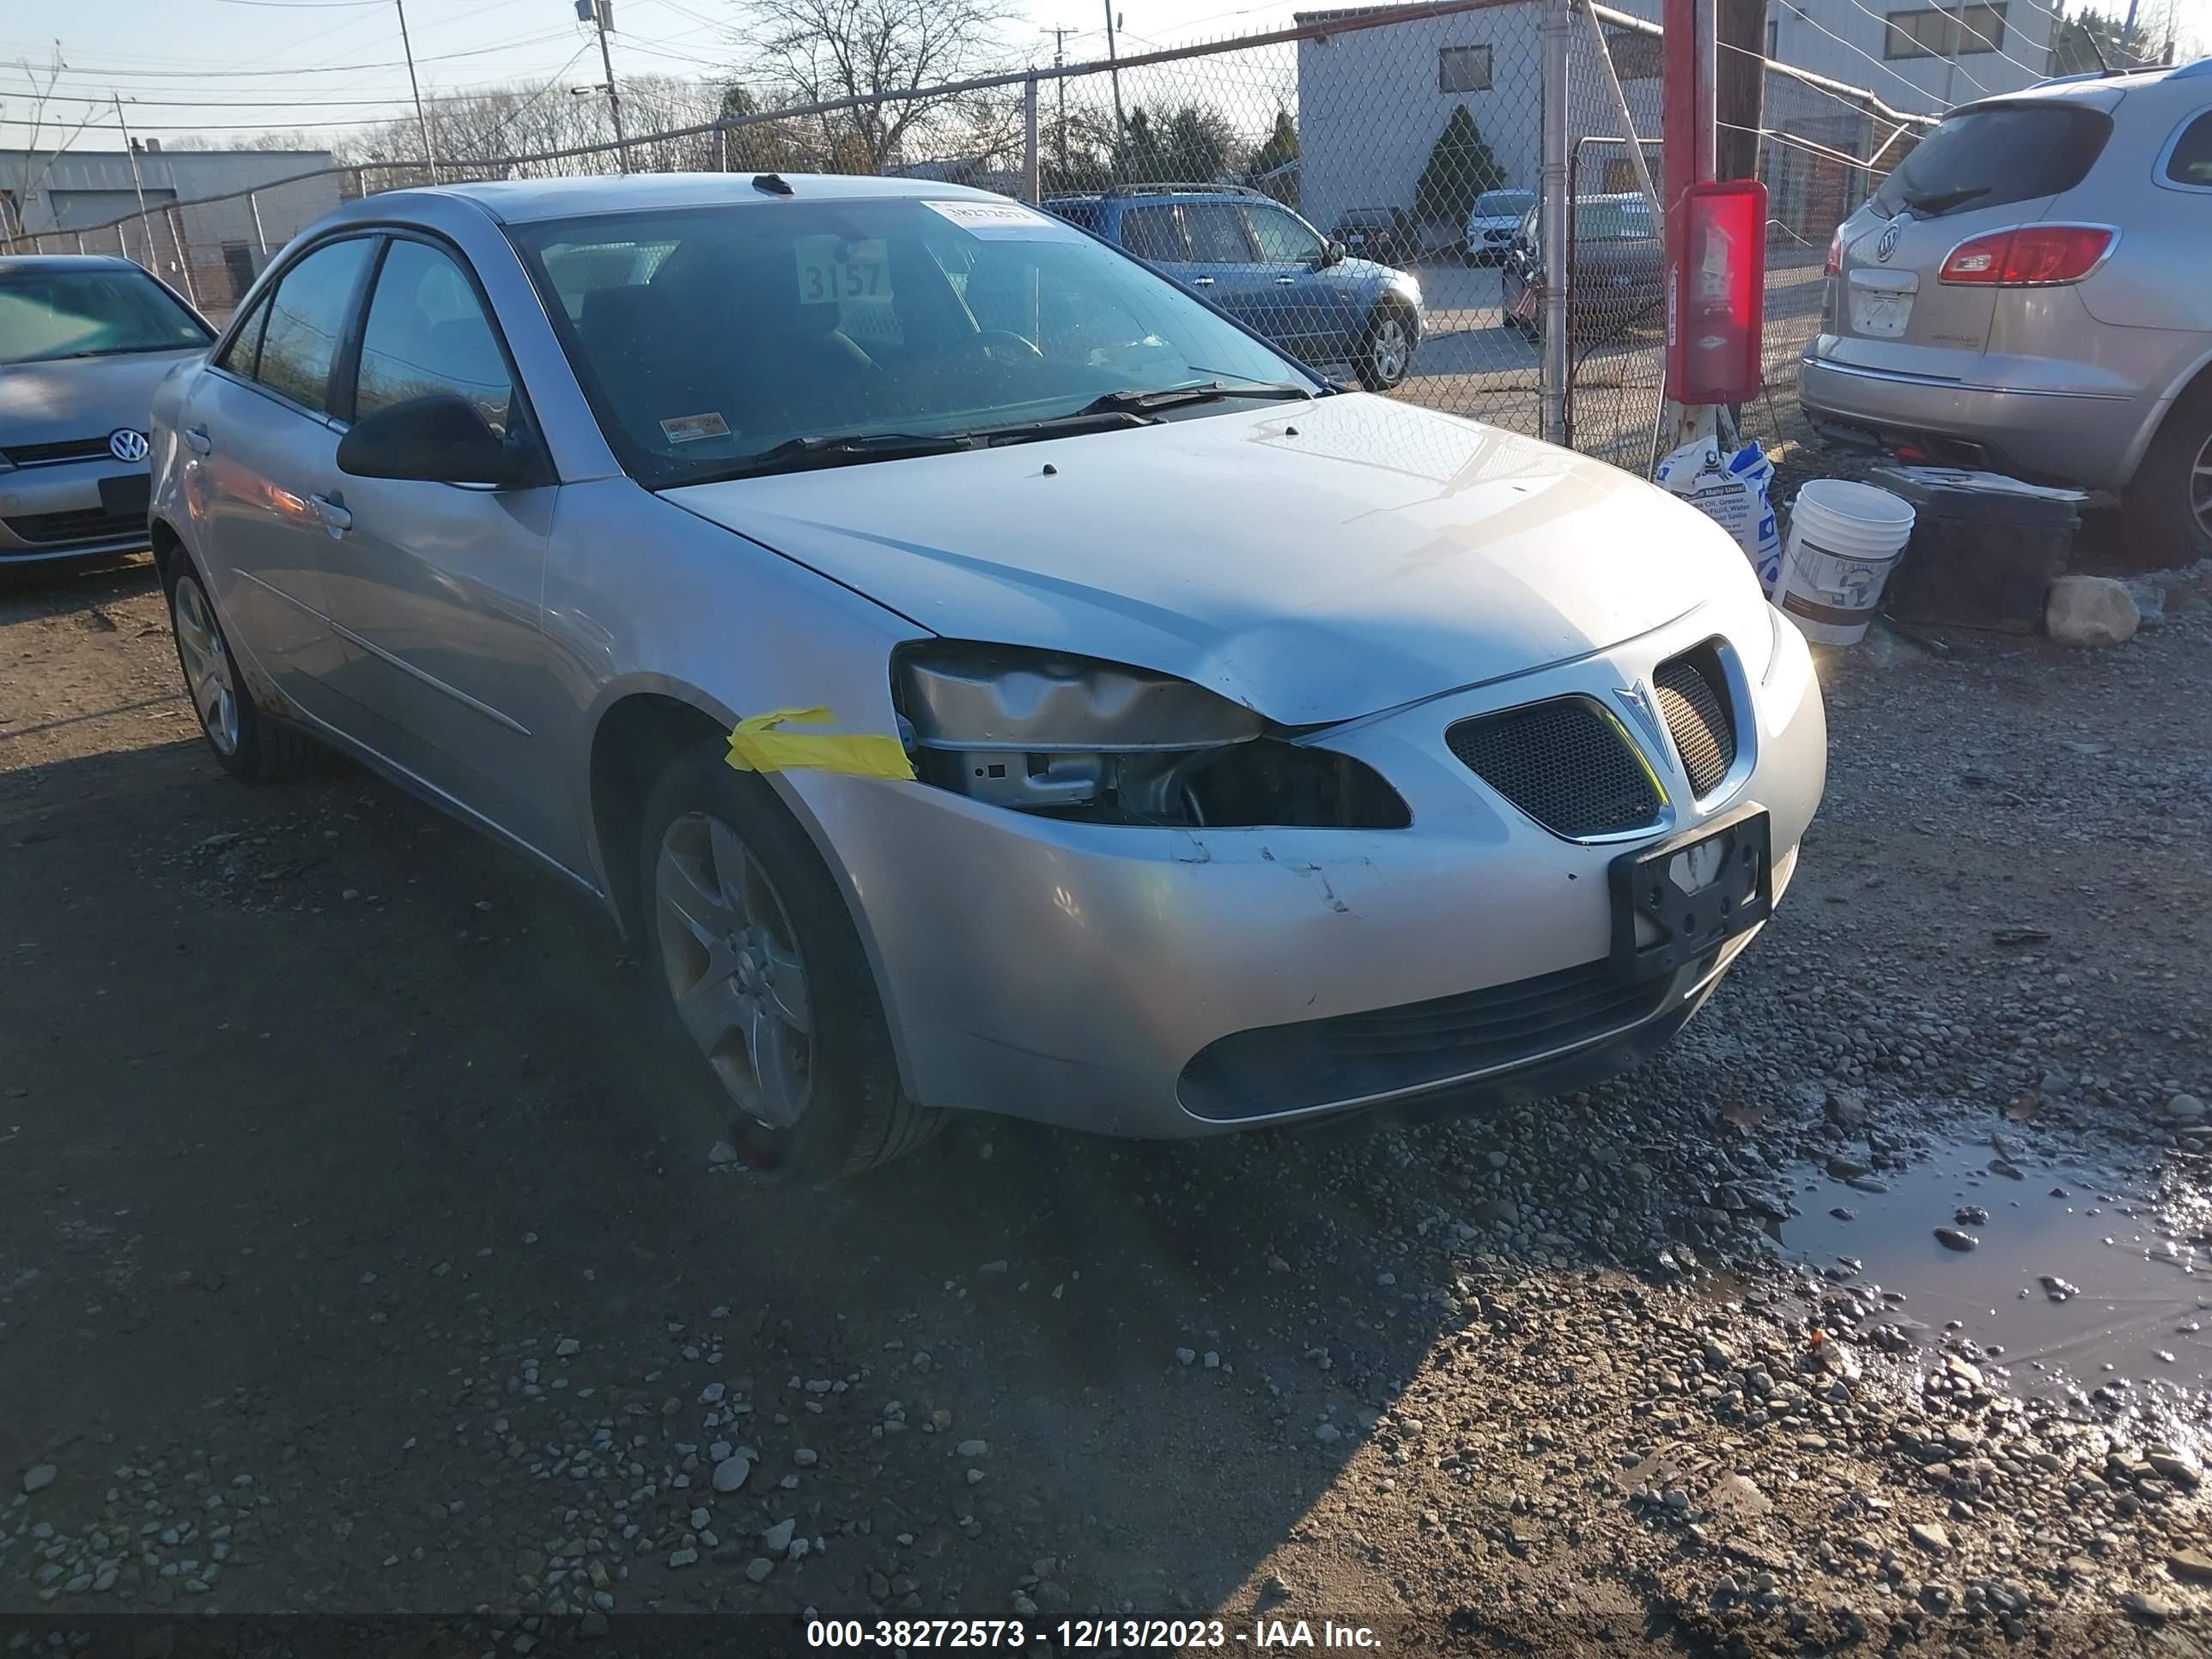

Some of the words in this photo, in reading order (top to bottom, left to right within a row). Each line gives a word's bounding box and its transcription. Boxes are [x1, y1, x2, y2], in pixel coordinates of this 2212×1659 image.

[805, 263, 879, 300] 3157
[1705, 487, 1724, 496] Many
[1728, 512, 1747, 520] Spills
